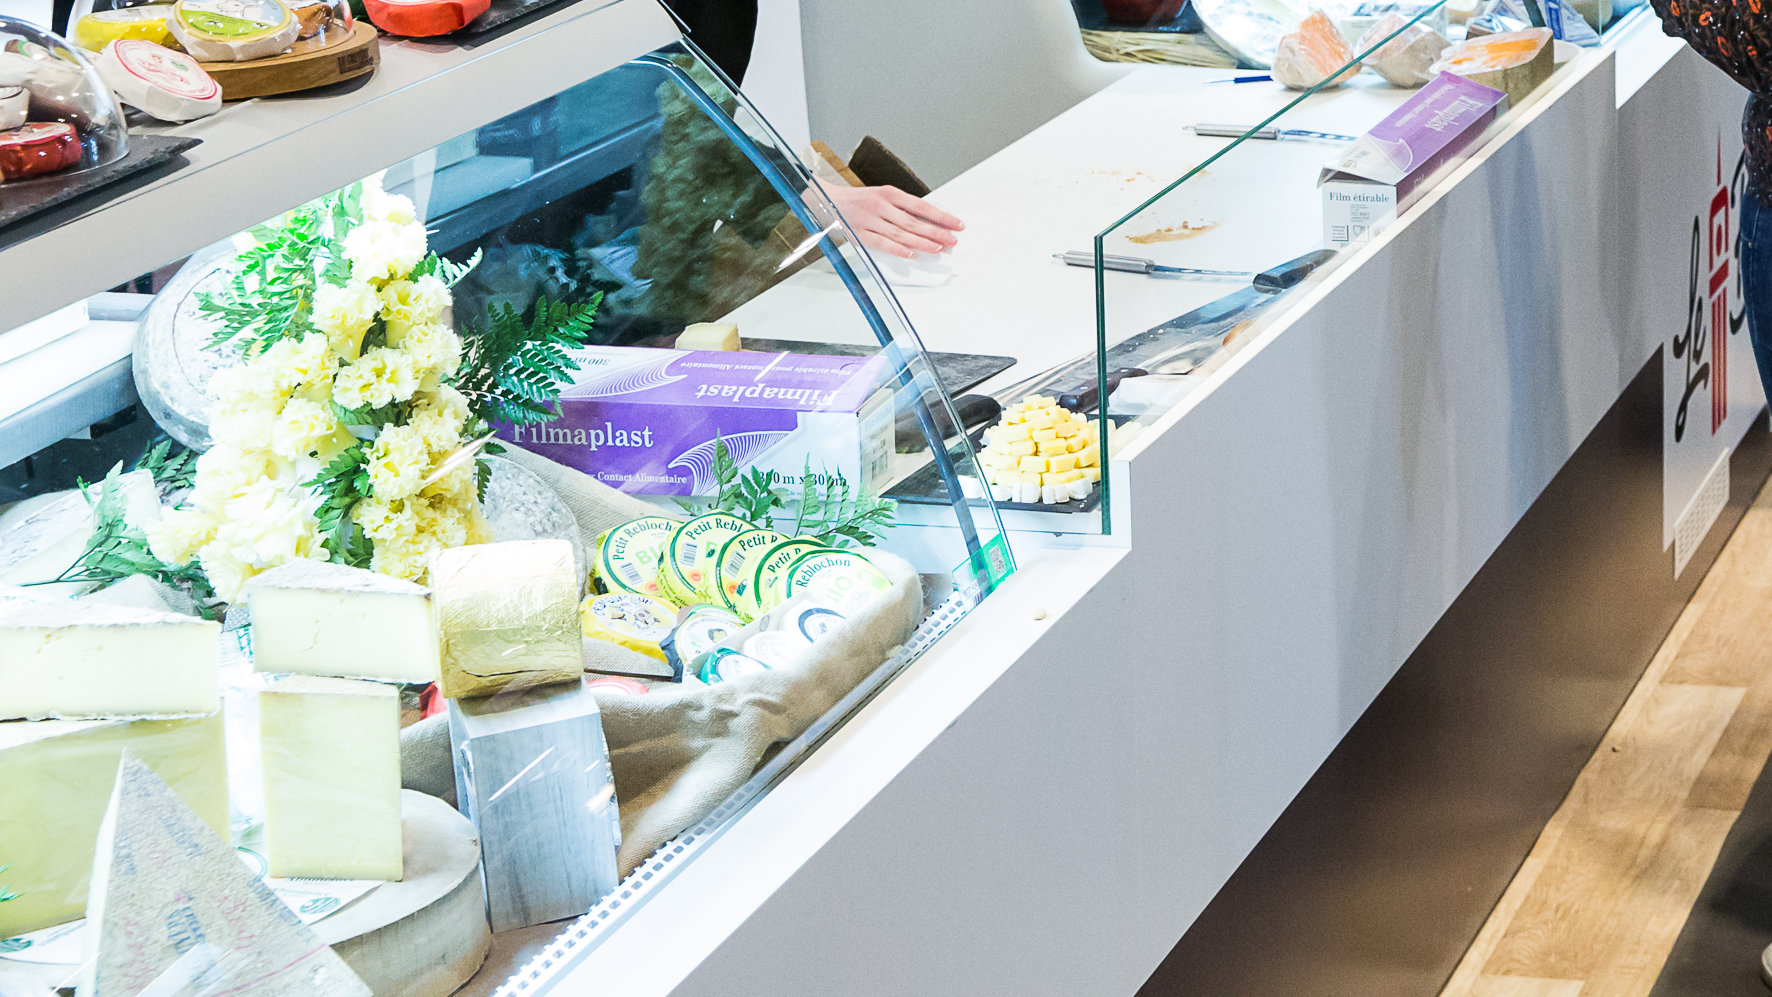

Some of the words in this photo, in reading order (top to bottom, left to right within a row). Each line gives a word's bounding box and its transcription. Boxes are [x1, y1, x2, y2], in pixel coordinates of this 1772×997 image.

[1329, 192, 1351, 201] Film
[1353, 192, 1390, 203] étirable
[680, 361, 734, 371] Alimentaire
[794, 365, 824, 375] étirable
[695, 383, 842, 406] Filmaplast
[513, 421, 654, 452] Filmaplast
[597, 471, 632, 482] Contact
[634, 472, 688, 484] Alimentaire
[759, 472, 780, 484] 30
[684, 521, 713, 541] Petit
[715, 517, 744, 533] Rebl
[612, 536, 629, 561] Petit
[623, 520, 677, 539] Rebloch
[737, 534, 767, 552] Petit
[767, 551, 792, 573] Petit
[795, 557, 851, 588] Reblochon
